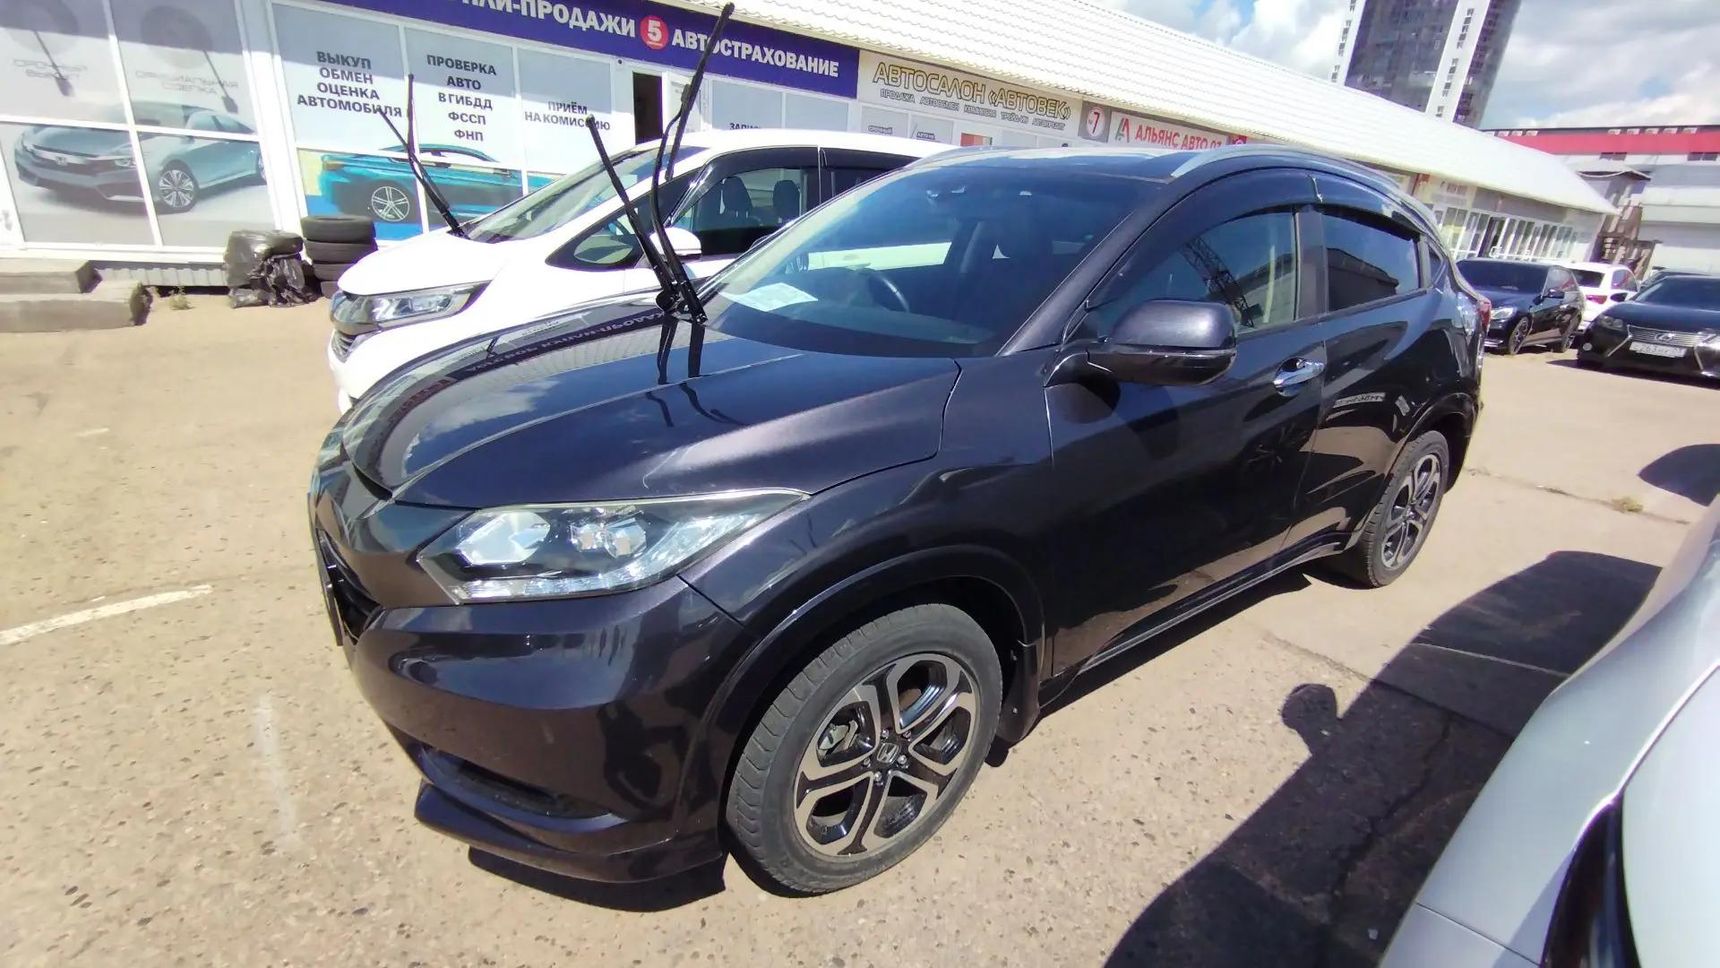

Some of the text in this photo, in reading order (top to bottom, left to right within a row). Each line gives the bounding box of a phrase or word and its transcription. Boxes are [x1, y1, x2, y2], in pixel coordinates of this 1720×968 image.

[462, 0, 636, 38] И-ПРОДАЖИ
[647, 19, 662, 42] 5
[317, 51, 372, 69] ВЫКУП
[427, 54, 497, 76] ПРОВЕРКА
[319, 67, 373, 84] ОБМЕН
[447, 75, 481, 90] АВТО
[873, 62, 986, 104] АВТОСАЛОН
[317, 82, 380, 100] ОЦЕНКА
[297, 94, 402, 118] АВТОМОБИЛЯ
[449, 94, 493, 111] ГИБДД
[548, 101, 588, 115] ПРИЁМ
[448, 111, 486, 125] ФССП
[524, 111, 542, 123] НА
[454, 129, 484, 142] ФНП
[1135, 124, 1180, 148] АЛЬЯНС
